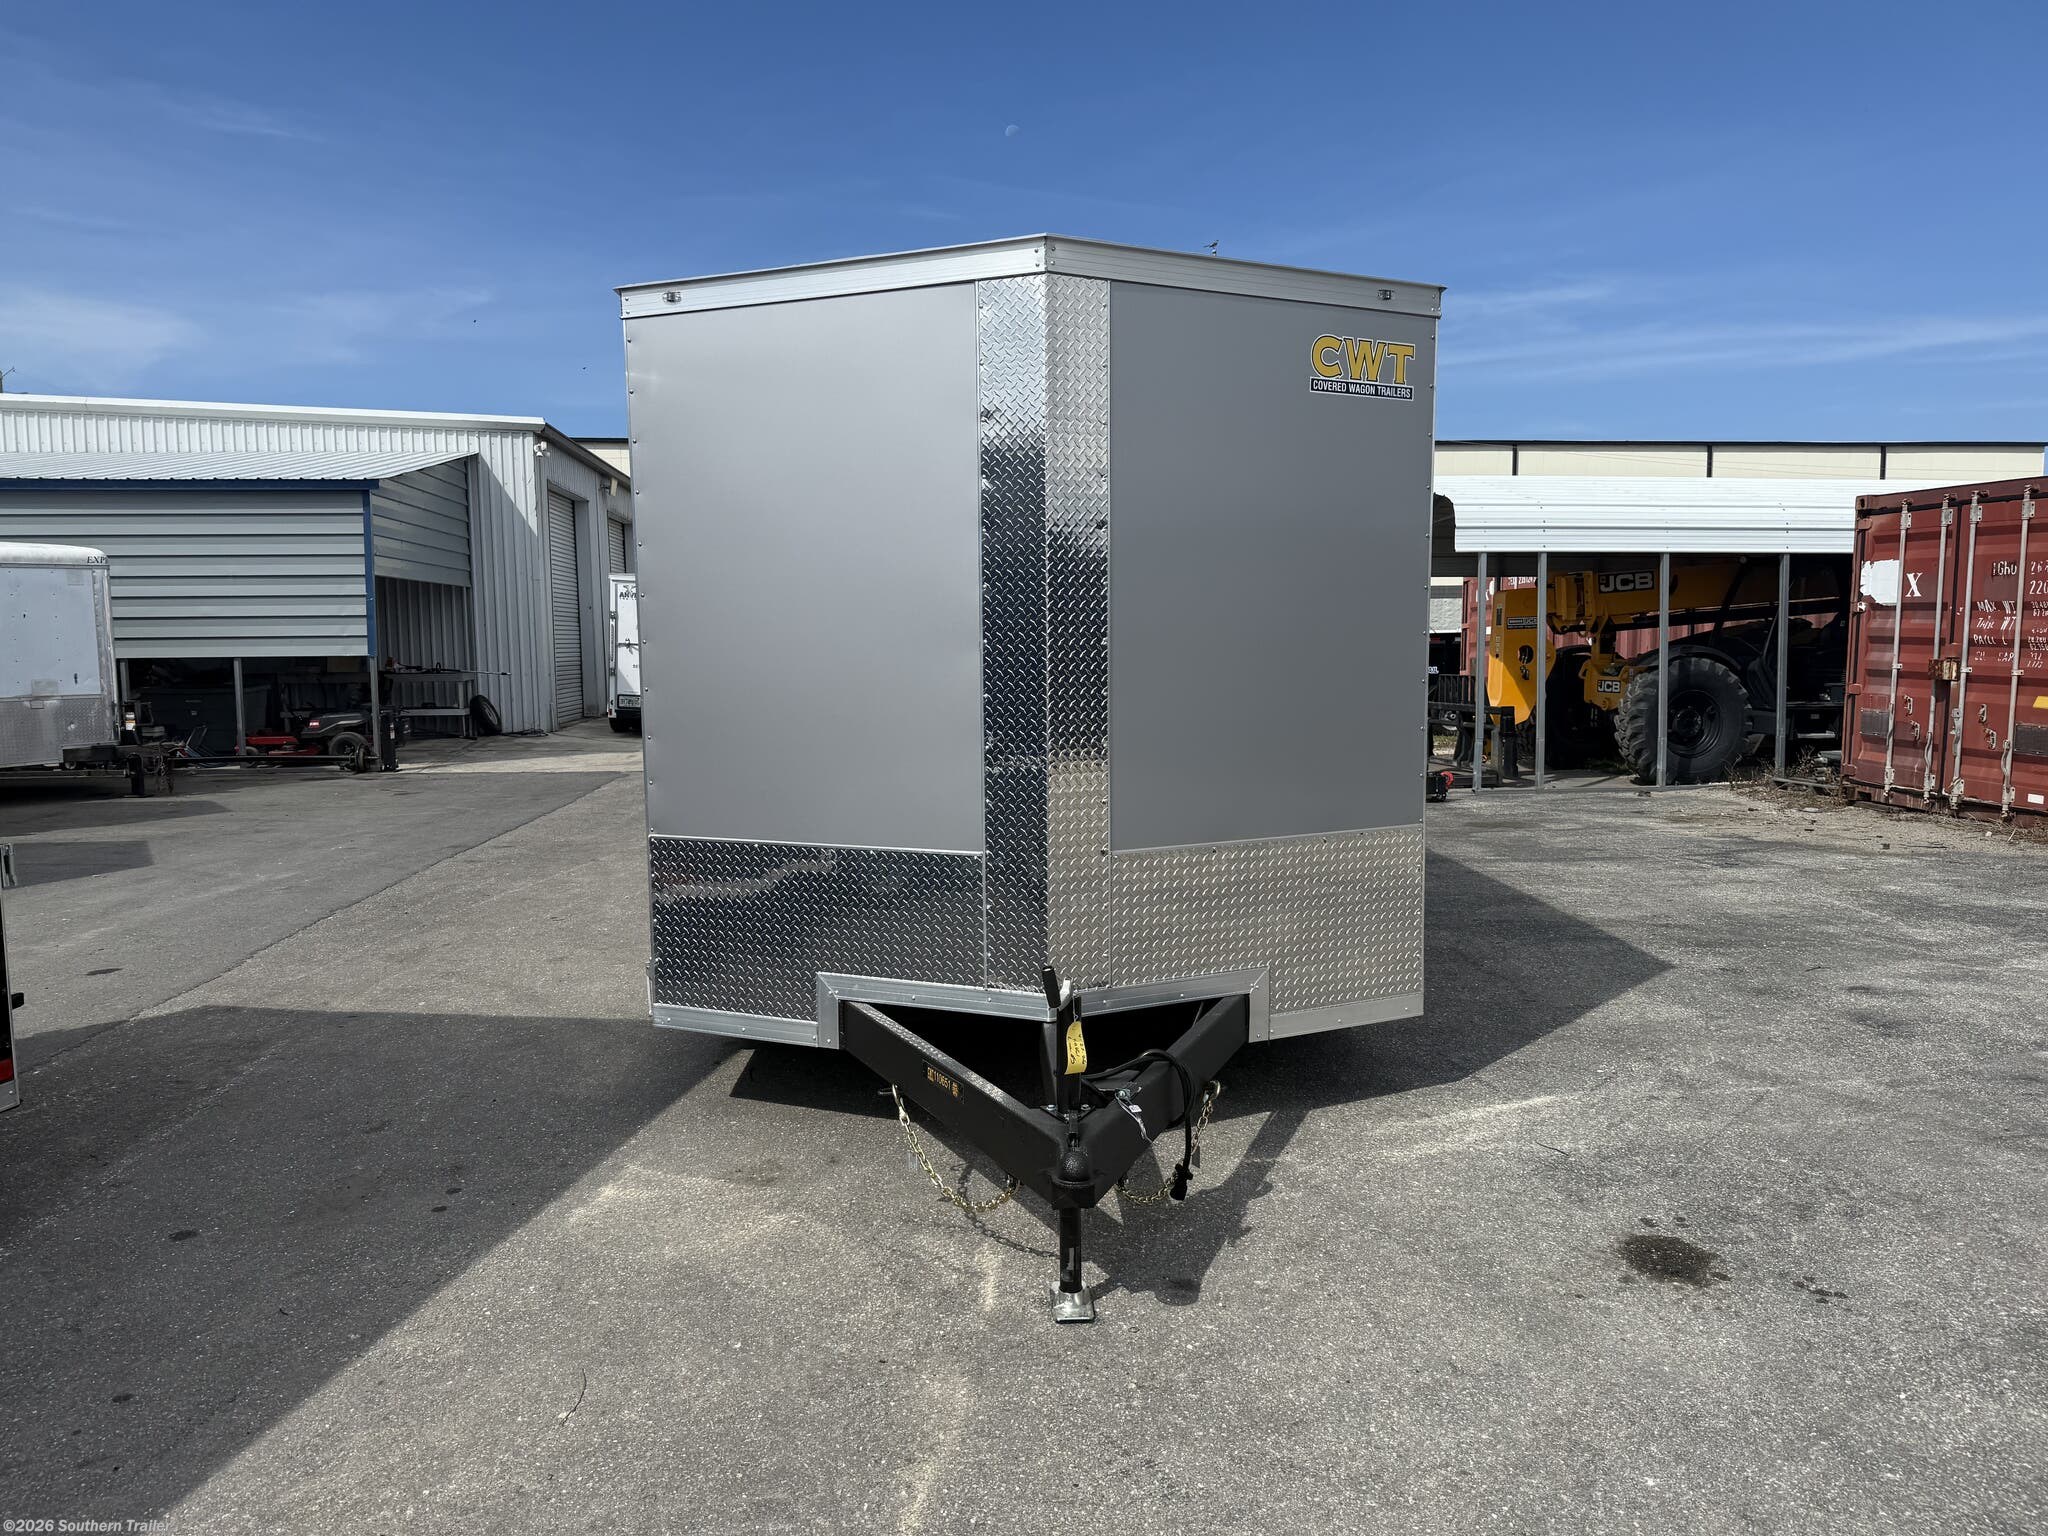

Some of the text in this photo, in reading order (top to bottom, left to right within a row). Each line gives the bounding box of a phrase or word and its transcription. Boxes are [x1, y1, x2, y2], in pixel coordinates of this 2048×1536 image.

[1311, 334, 1415, 385] CWT
[1313, 380, 1411, 398] COVERED WAGON TRAILERS
[1599, 572, 1653, 593] JCB
[1905, 572, 1923, 598] X
[1598, 681, 1620, 692] JCB
